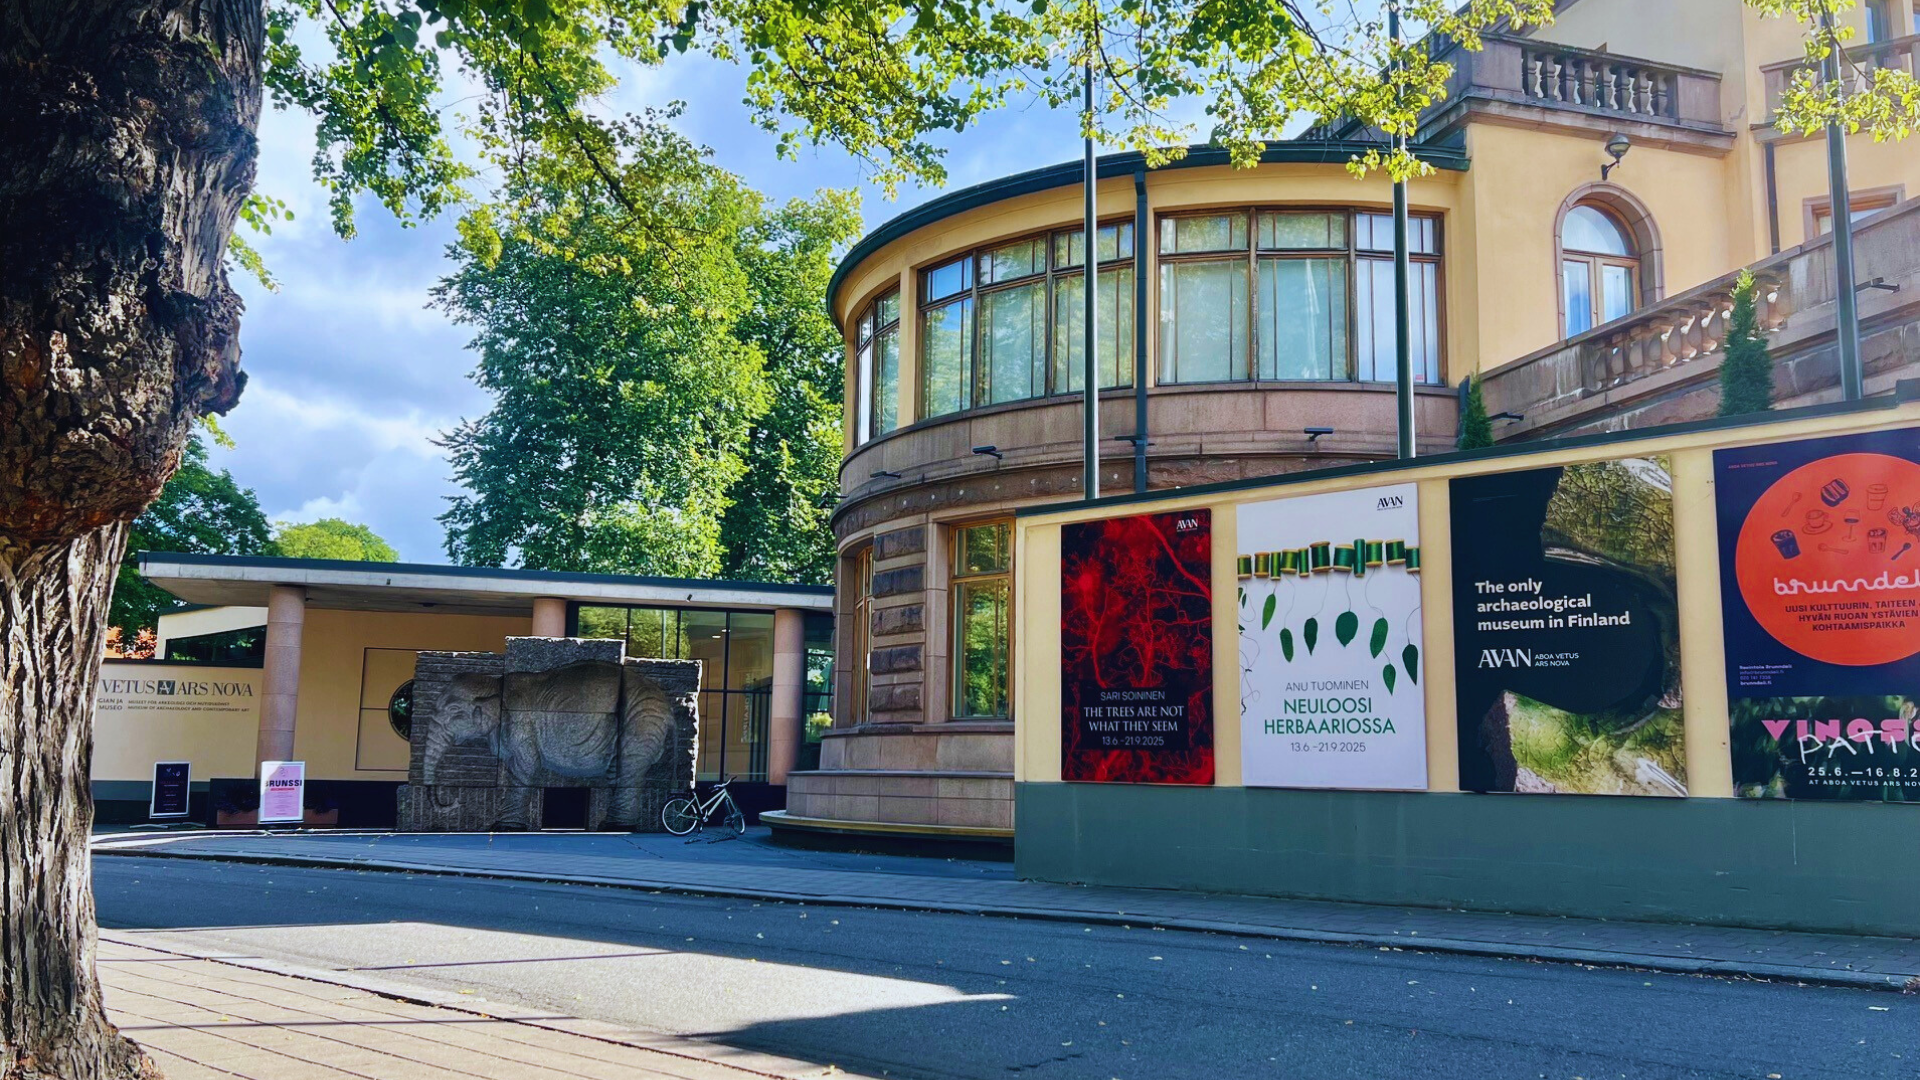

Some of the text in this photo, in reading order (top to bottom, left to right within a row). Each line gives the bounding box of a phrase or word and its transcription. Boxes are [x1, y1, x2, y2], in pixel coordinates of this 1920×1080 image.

[1377, 496, 1403, 508] AVAN
[1177, 518, 1198, 530] AVAN
[1475, 577, 1543, 595] The only
[1477, 593, 1591, 612] archaeological
[1785, 605, 1808, 613] UUSI
[1876, 600, 1916, 609] TAITEEN
[1477, 610, 1631, 631] museum in Finland
[1798, 609, 1919, 622] HYVÄN RUOAN YSTÄVIEN
[1812, 621, 1906, 632] KOHTAAMISPAIKKA
[1478, 648, 1532, 668] AVAN
[1550, 659, 1570, 667] NOVA
[102, 679, 156, 694] VETUS
[176, 681, 208, 696] ARS
[212, 682, 253, 697] NOVA
[1285, 680, 1369, 692] ANU TUOMINEN
[1100, 691, 1166, 701] SARI SOININEN
[1083, 705, 1185, 718] THE TREES ARE NOT
[1283, 697, 1372, 714] NEULOOSI
[1088, 721, 1179, 732] WHAT THEY SEEM
[1264, 717, 1396, 735] HERBAARIOSSA
